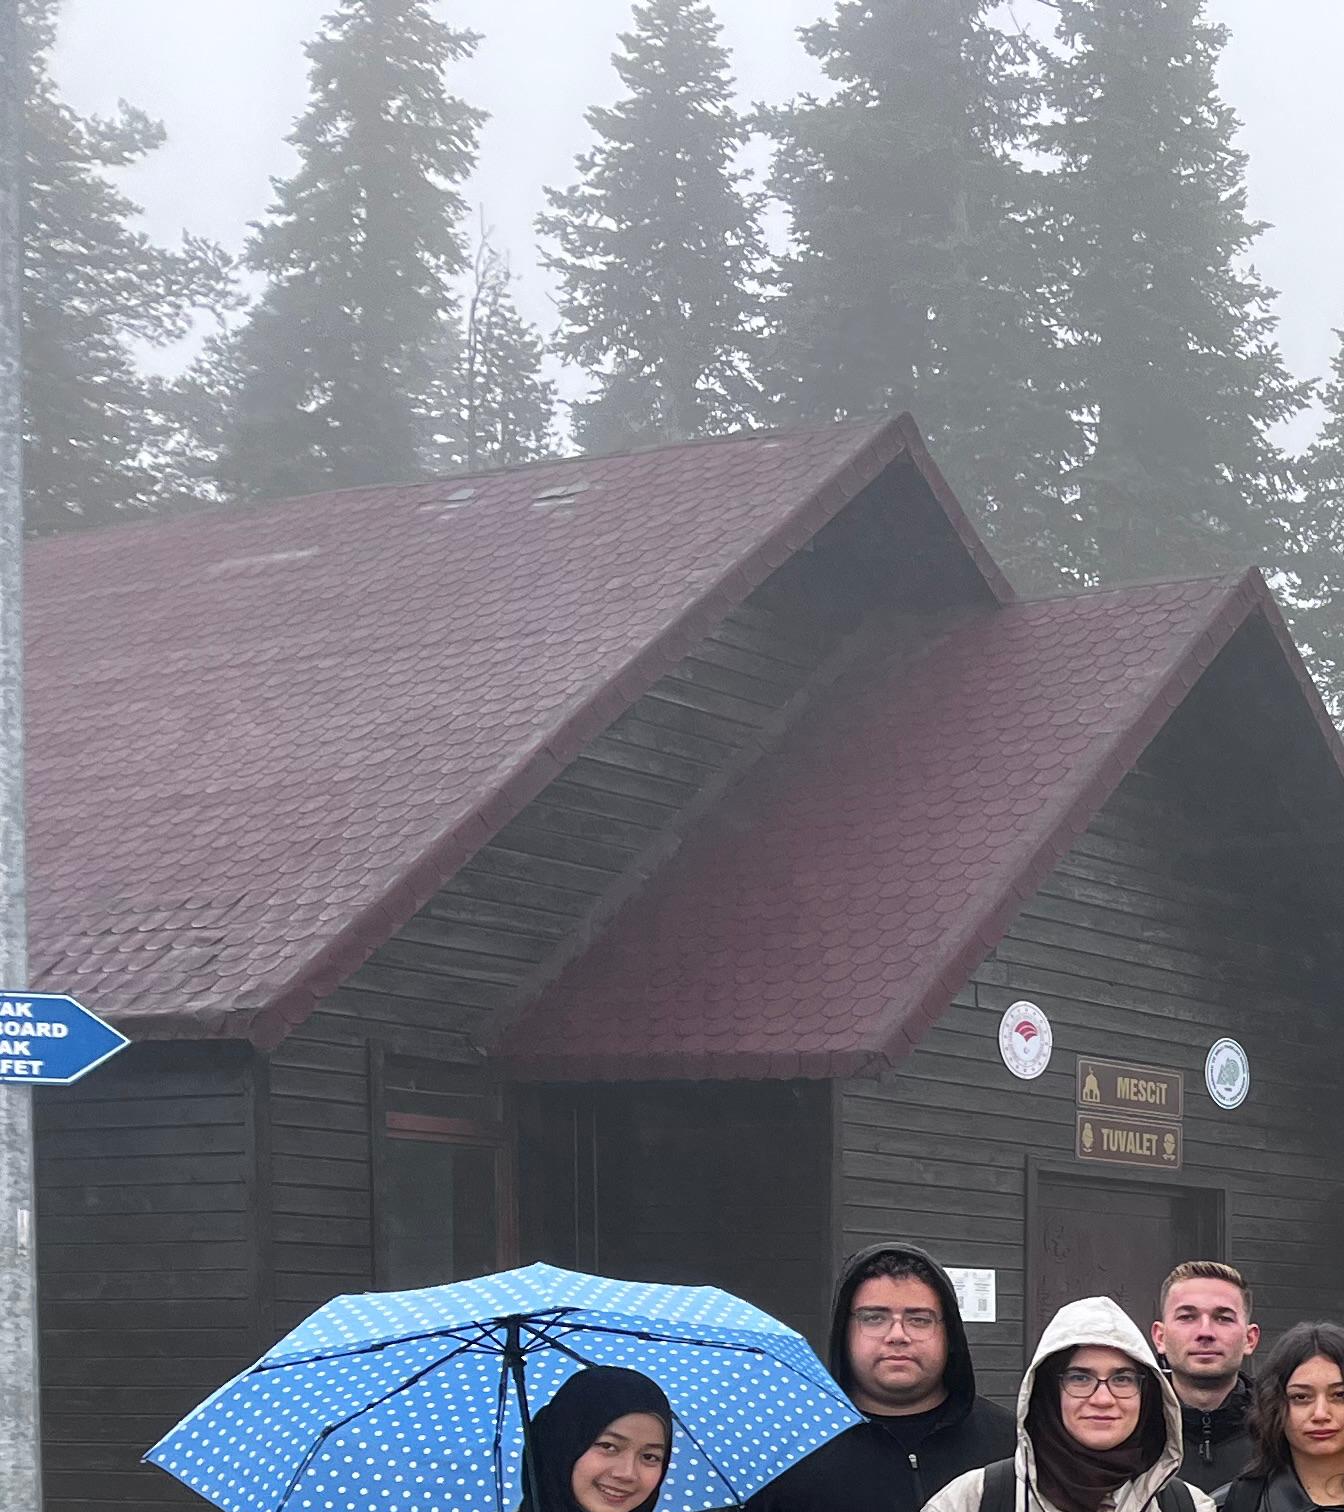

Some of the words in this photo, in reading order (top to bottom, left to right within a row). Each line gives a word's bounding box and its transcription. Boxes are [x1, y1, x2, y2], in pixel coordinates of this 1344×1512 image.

[0, 1002, 33, 1018] AK
[0, 1021, 69, 1038] OARD
[1101, 1128, 1158, 1156] TUVALET
